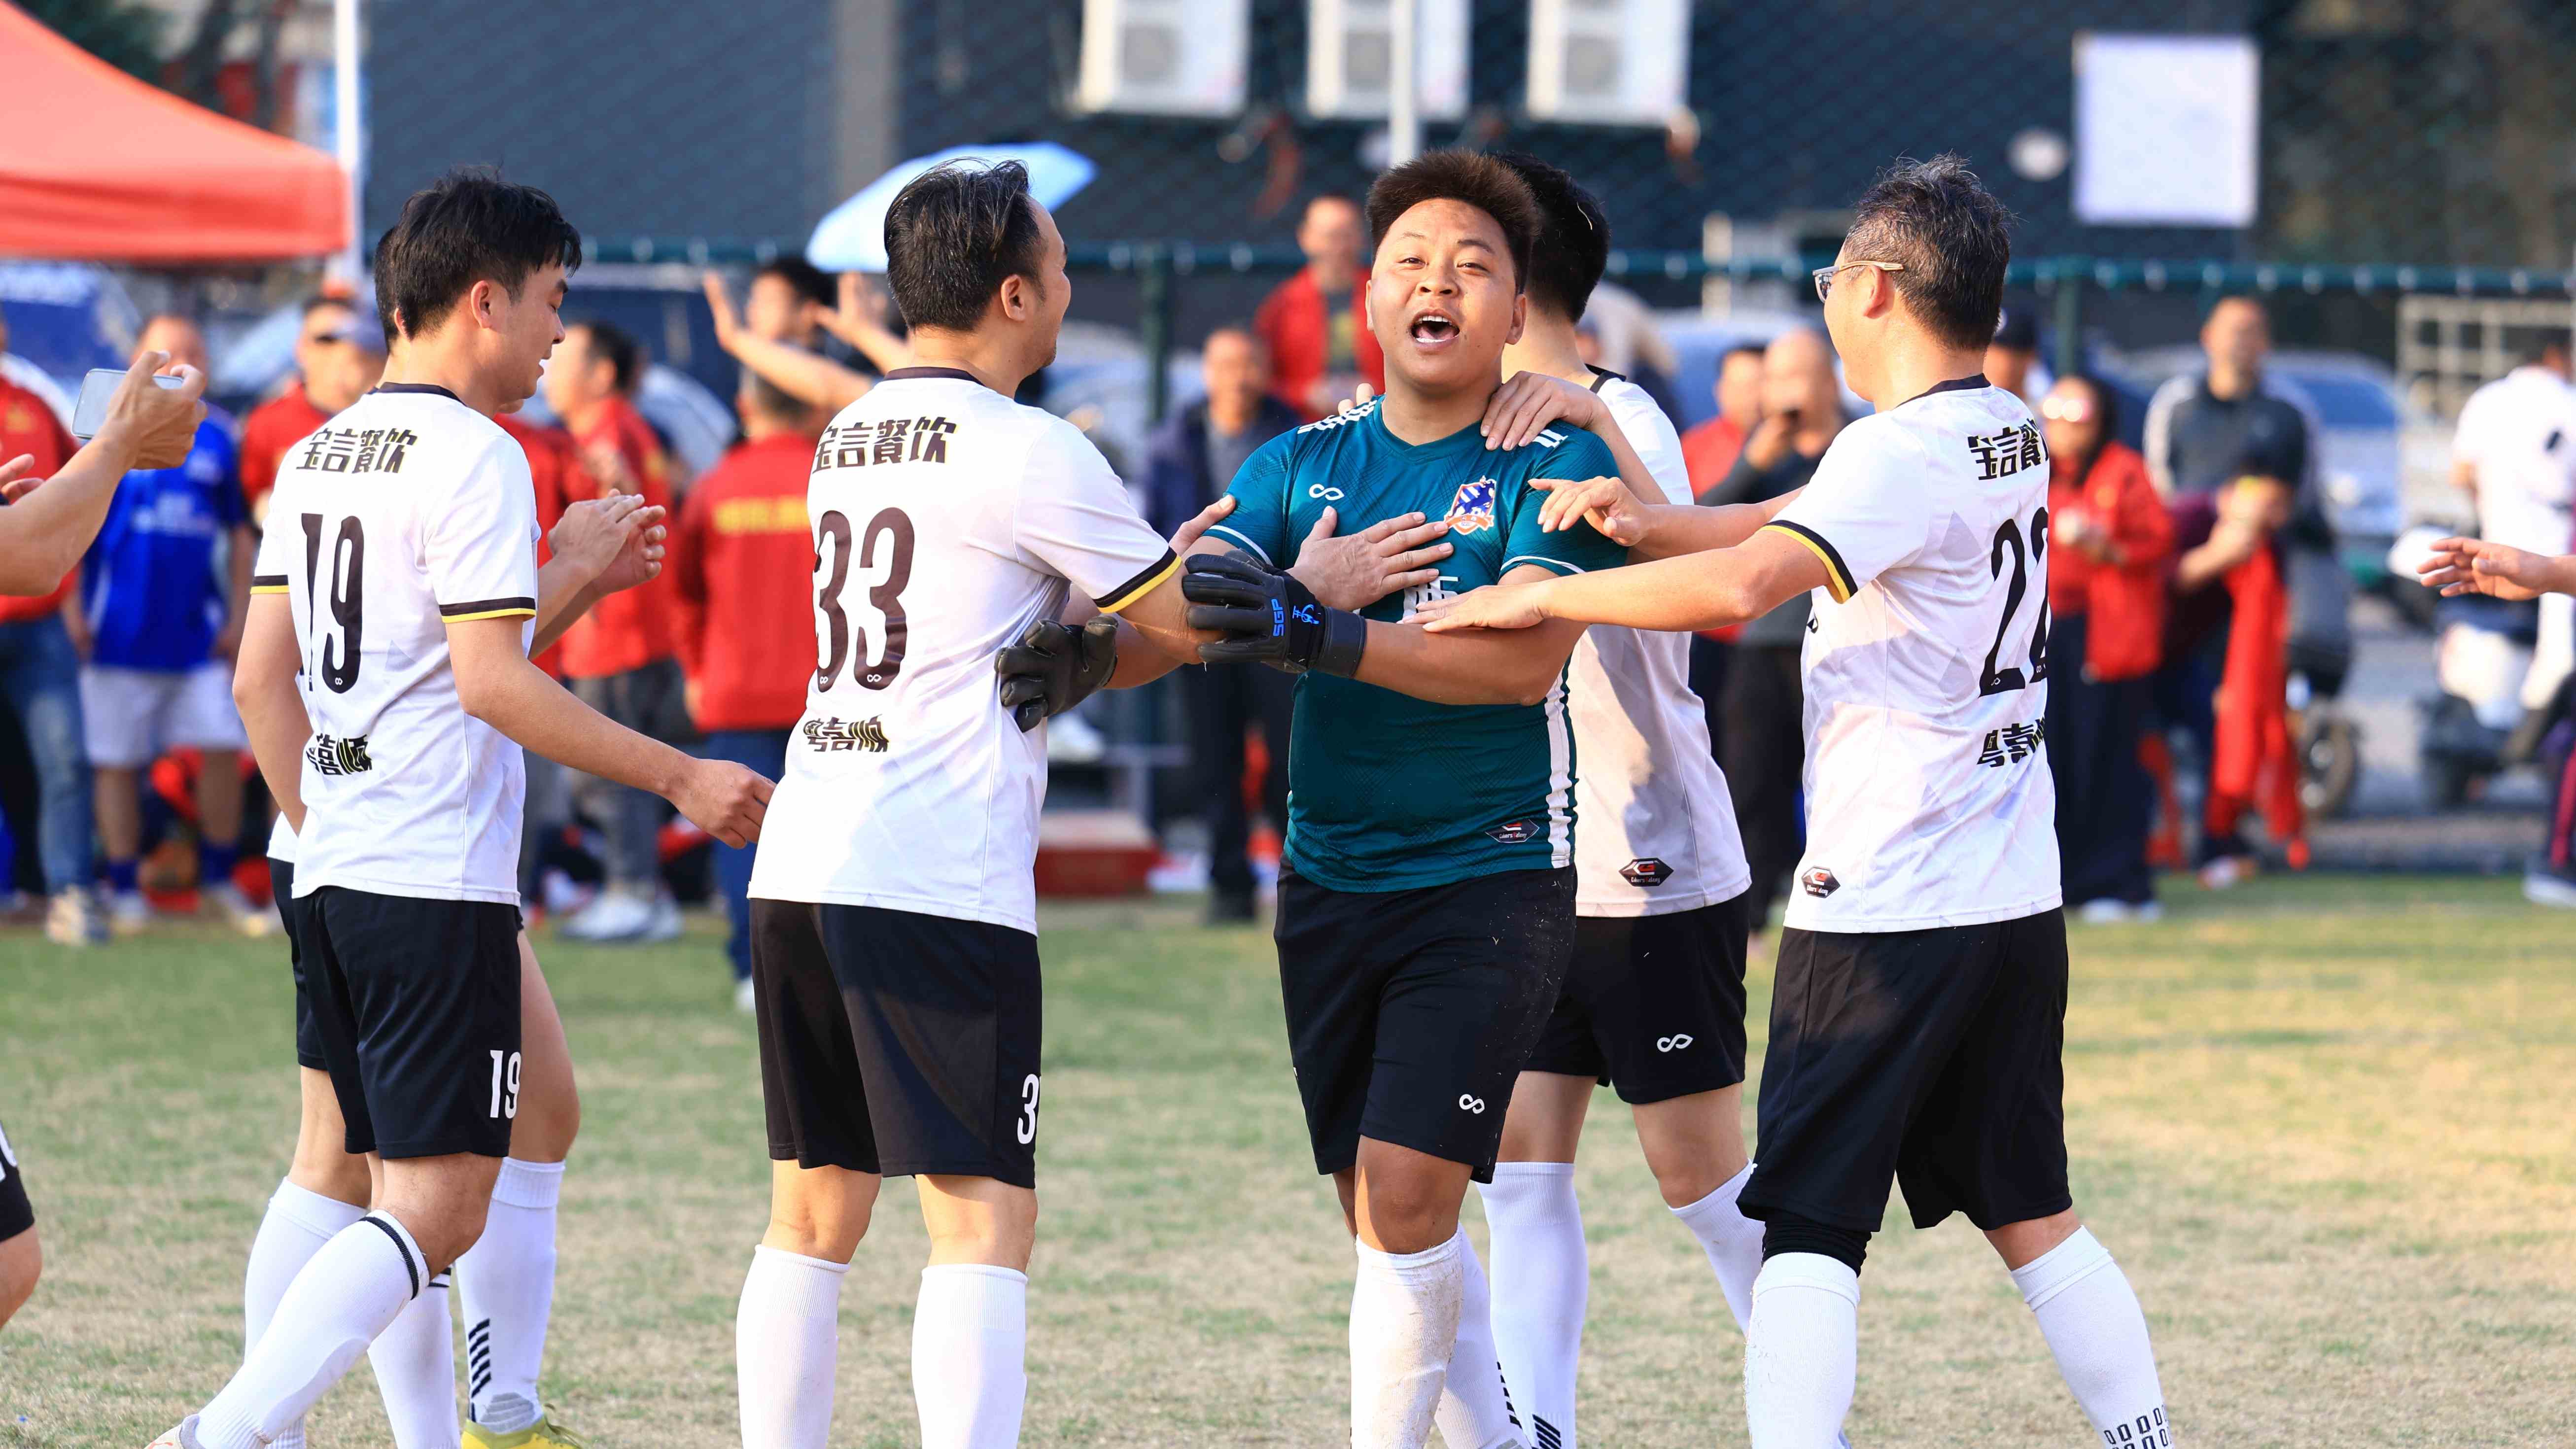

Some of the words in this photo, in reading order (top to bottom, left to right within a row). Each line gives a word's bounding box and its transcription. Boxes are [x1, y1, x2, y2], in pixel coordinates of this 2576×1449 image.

[301, 513, 364, 694] 19
[814, 507, 915, 692] 33
[1271, 598, 1285, 637] SGP
[490, 1049, 522, 1119] 19
[1017, 1073, 1041, 1144] 3
